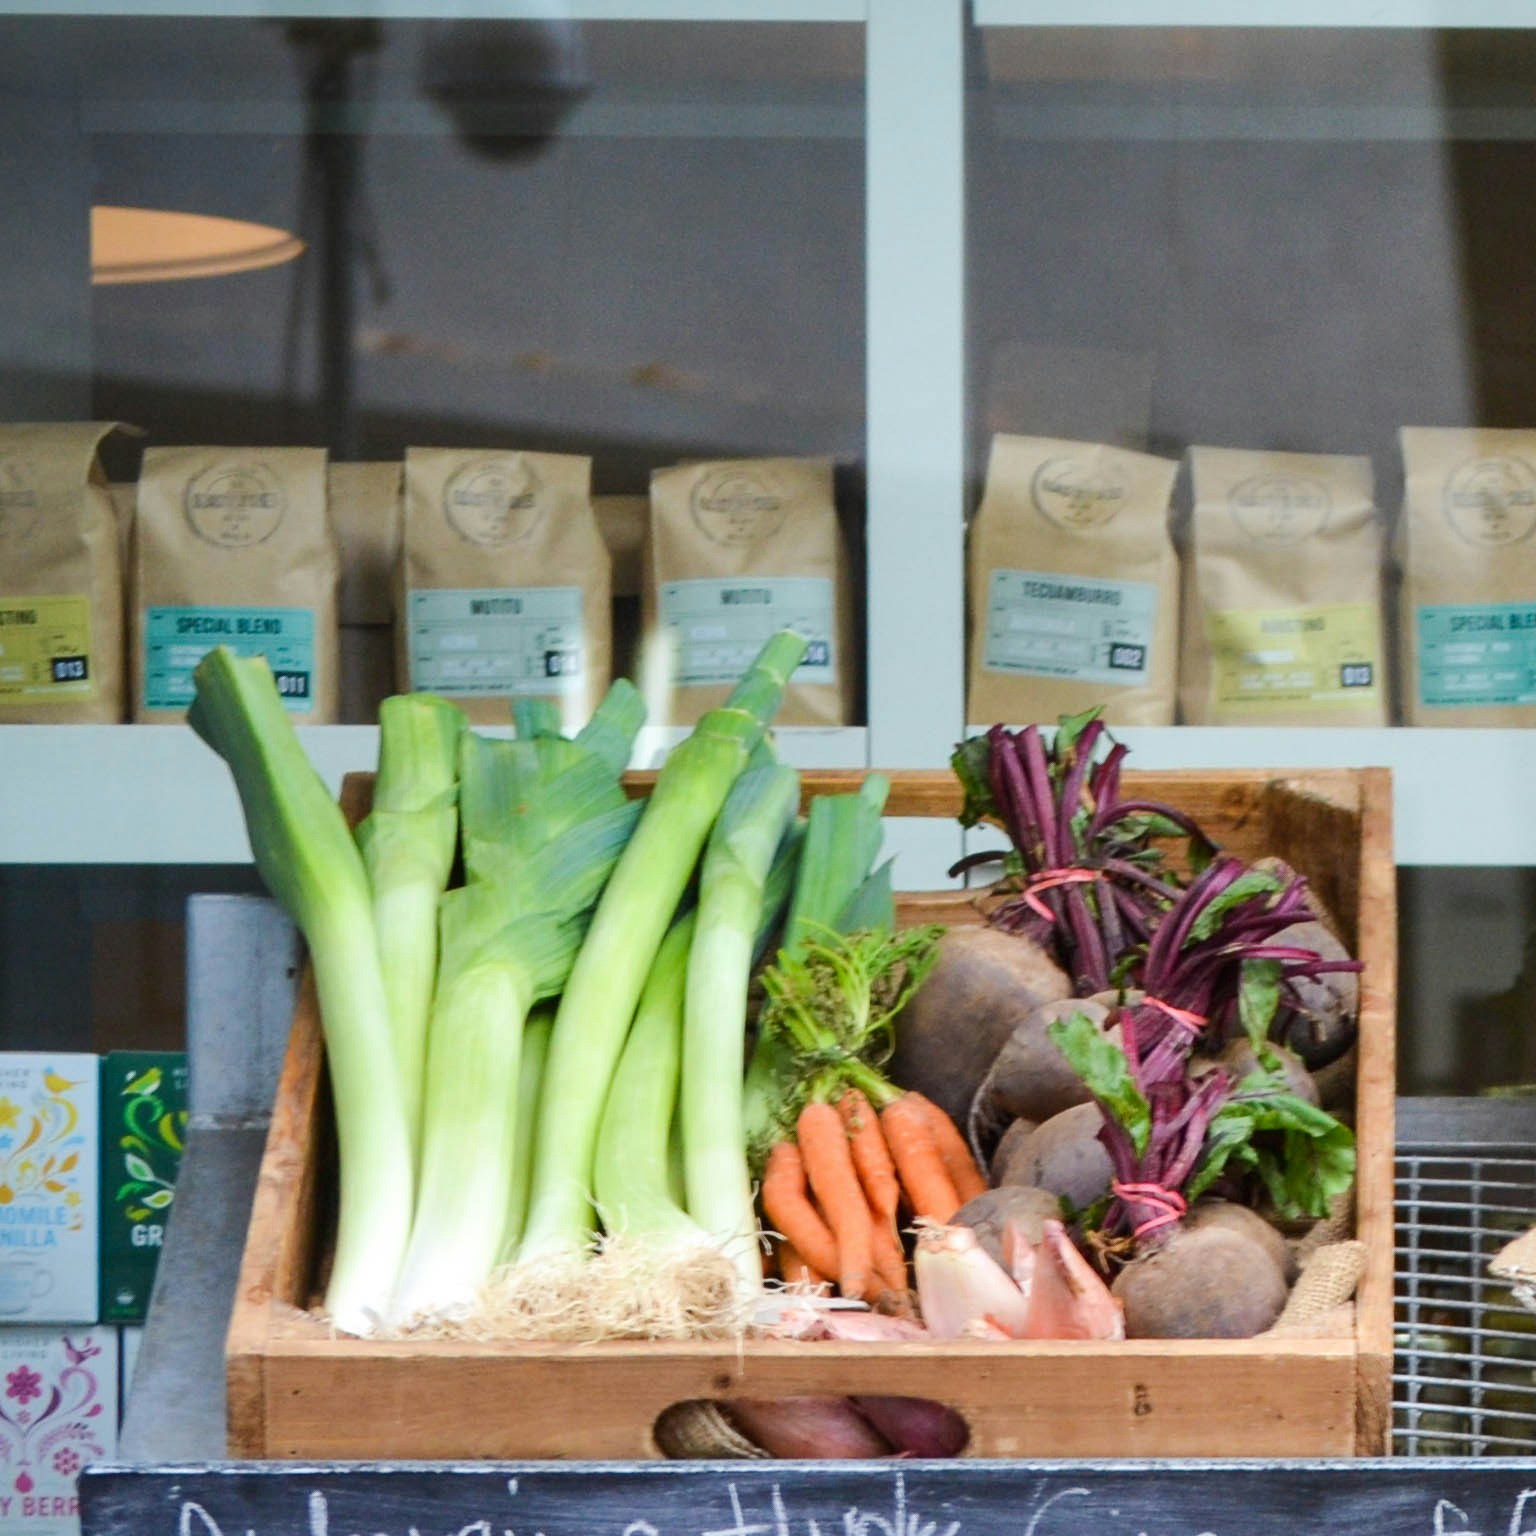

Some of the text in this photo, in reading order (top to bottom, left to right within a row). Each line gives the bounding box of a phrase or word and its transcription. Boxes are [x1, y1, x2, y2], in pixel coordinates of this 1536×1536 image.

[176, 616, 282, 636] SPECIAL BLEND
[1450, 614, 1505, 632] SPECIAL
[130, 1224, 165, 1247] GR
[22, 1496, 80, 1517] BERR
